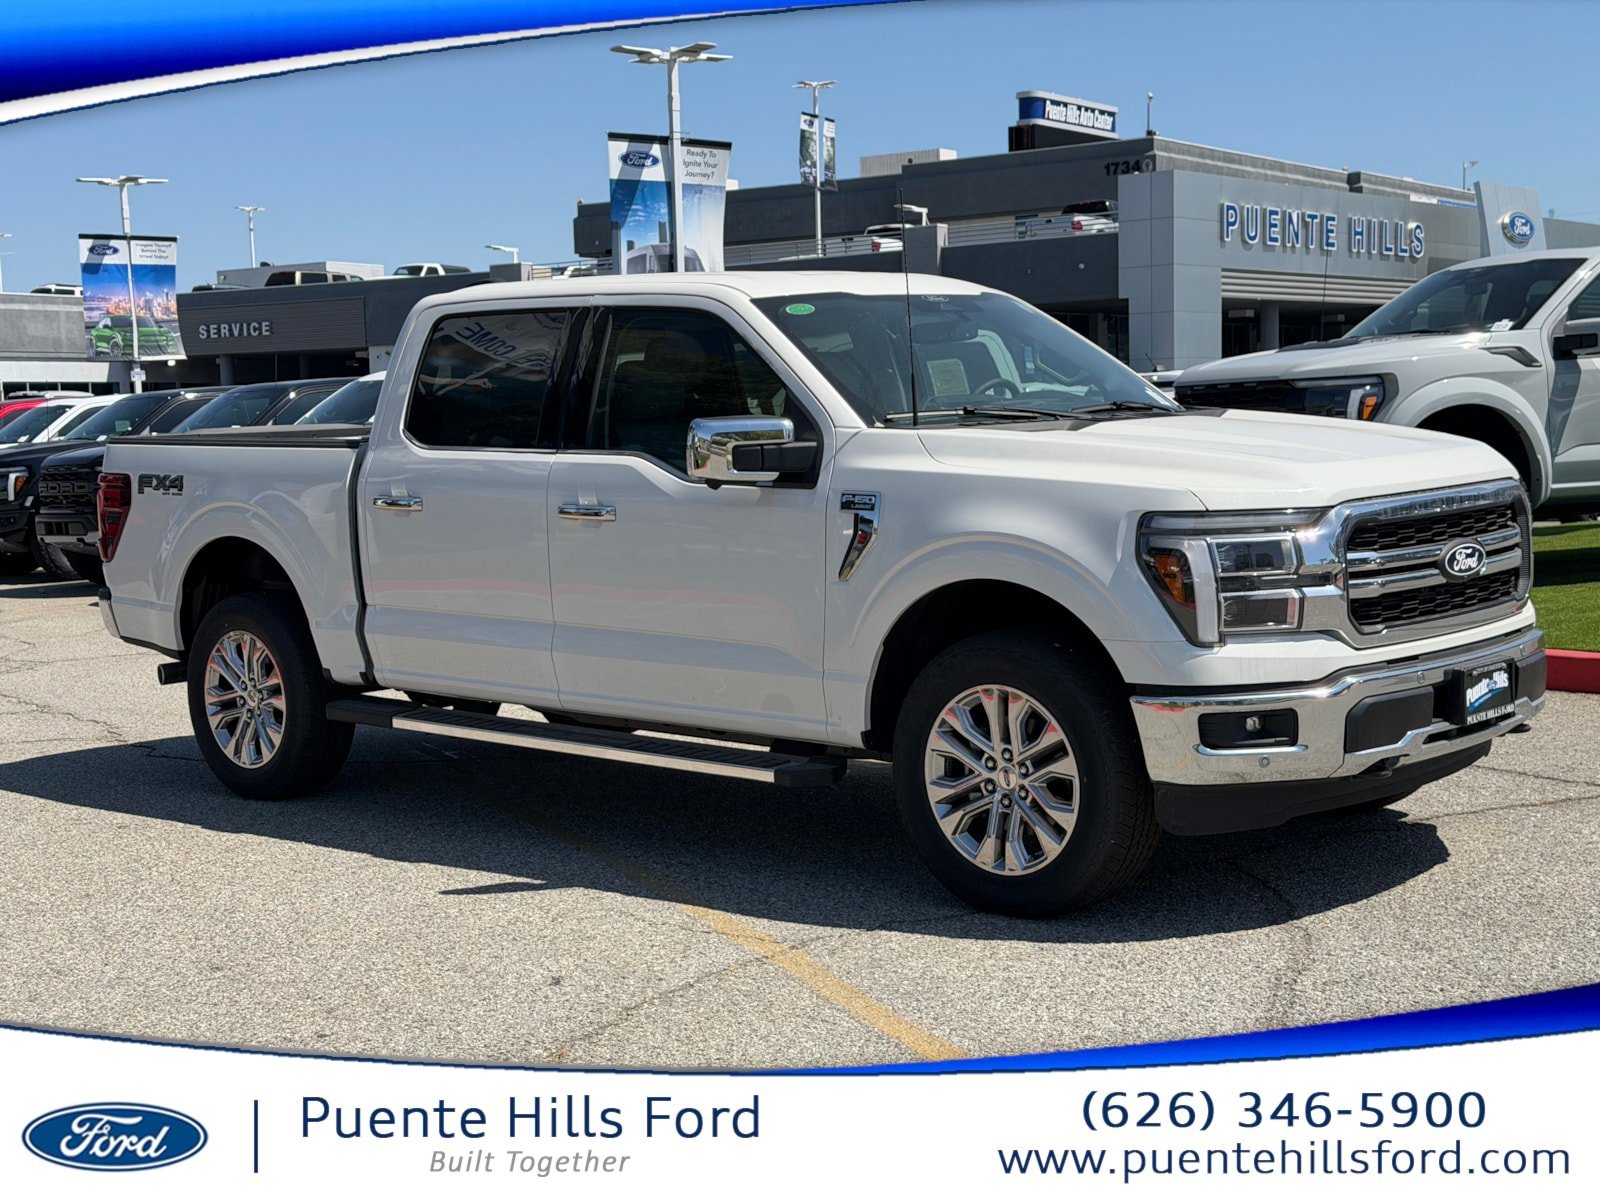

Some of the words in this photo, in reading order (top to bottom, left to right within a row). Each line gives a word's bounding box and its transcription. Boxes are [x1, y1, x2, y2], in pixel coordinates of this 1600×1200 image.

[1045, 99, 1066, 121] Puente
[1066, 104, 1080, 124] Hills
[1080, 107, 1094, 127] Auto
[1094, 109, 1113, 130] Center
[627, 153, 653, 166] Ford
[686, 149, 707, 158] Ready
[683, 160, 701, 169] Ignite
[703, 160, 718, 169] Your
[685, 171, 714, 180] Journey?
[1222, 202, 1337, 250] PUENTE
[1350, 216, 1425, 258] HILLS
[199, 321, 271, 339] SERVICE
[40, 481, 90, 496] FORD
[138, 474, 184, 494] FX4
[1453, 548, 1479, 571] Ford
